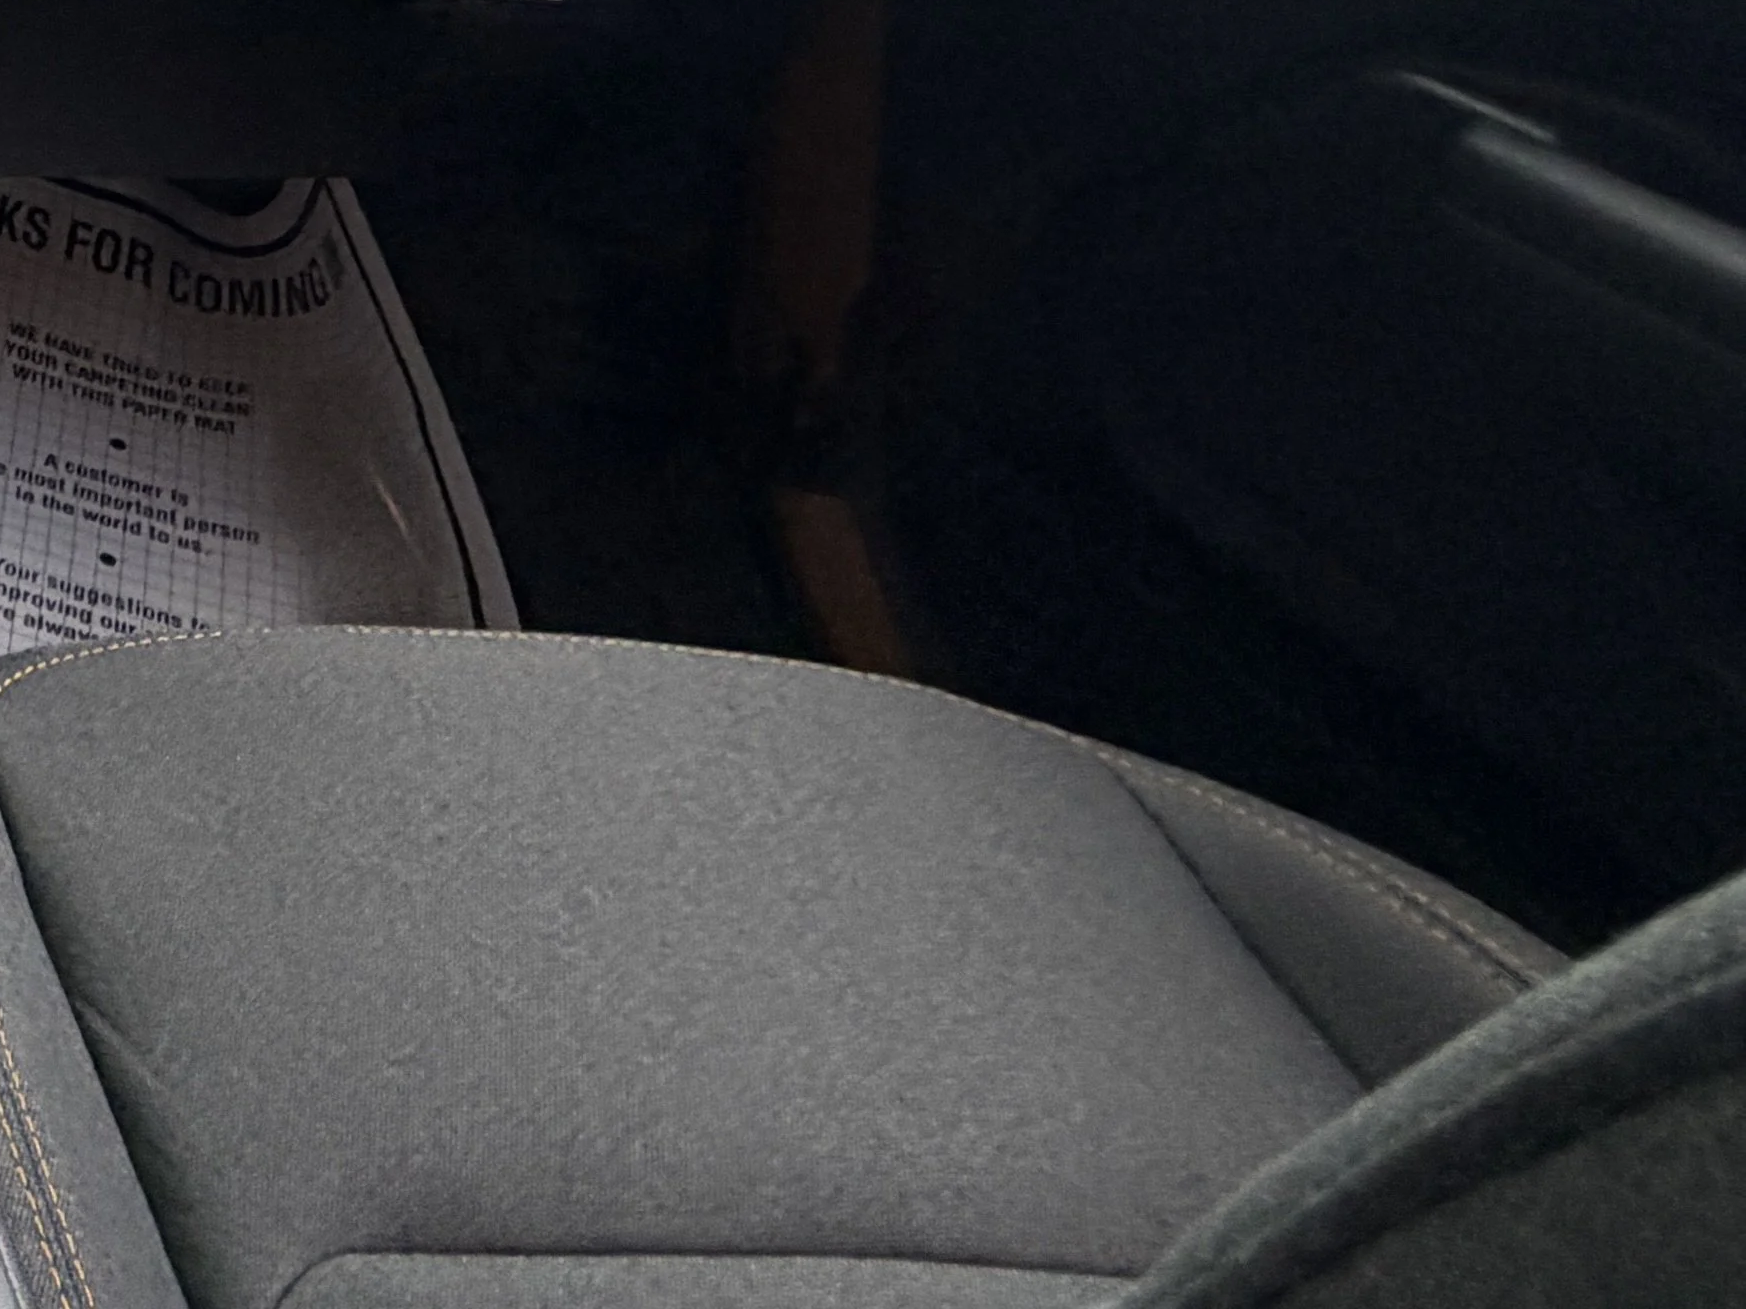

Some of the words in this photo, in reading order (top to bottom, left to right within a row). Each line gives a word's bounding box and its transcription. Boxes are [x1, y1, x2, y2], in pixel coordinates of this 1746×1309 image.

[64, 219, 154, 288] FOR
[168, 258, 328, 317] COMING
[6, 339, 56, 369] YOUR
[9, 322, 36, 342] WE
[45, 333, 92, 361] HAVE
[12, 363, 62, 390] WITH
[72, 382, 113, 407] THIS
[122, 396, 187, 425] PAPER
[194, 414, 235, 435] MAT
[13, 467, 65, 492] most
[72, 481, 177, 525] important
[184, 516, 260, 545] person
[43, 453, 58, 470] A
[64, 460, 163, 498] customer
[170, 488, 188, 506] is
[15, 486, 34, 503] in
[42, 495, 74, 516] the
[82, 508, 141, 535] world
[149, 525, 169, 544] to
[46, 574, 182, 628] suggestions
[100, 614, 136, 634] our
